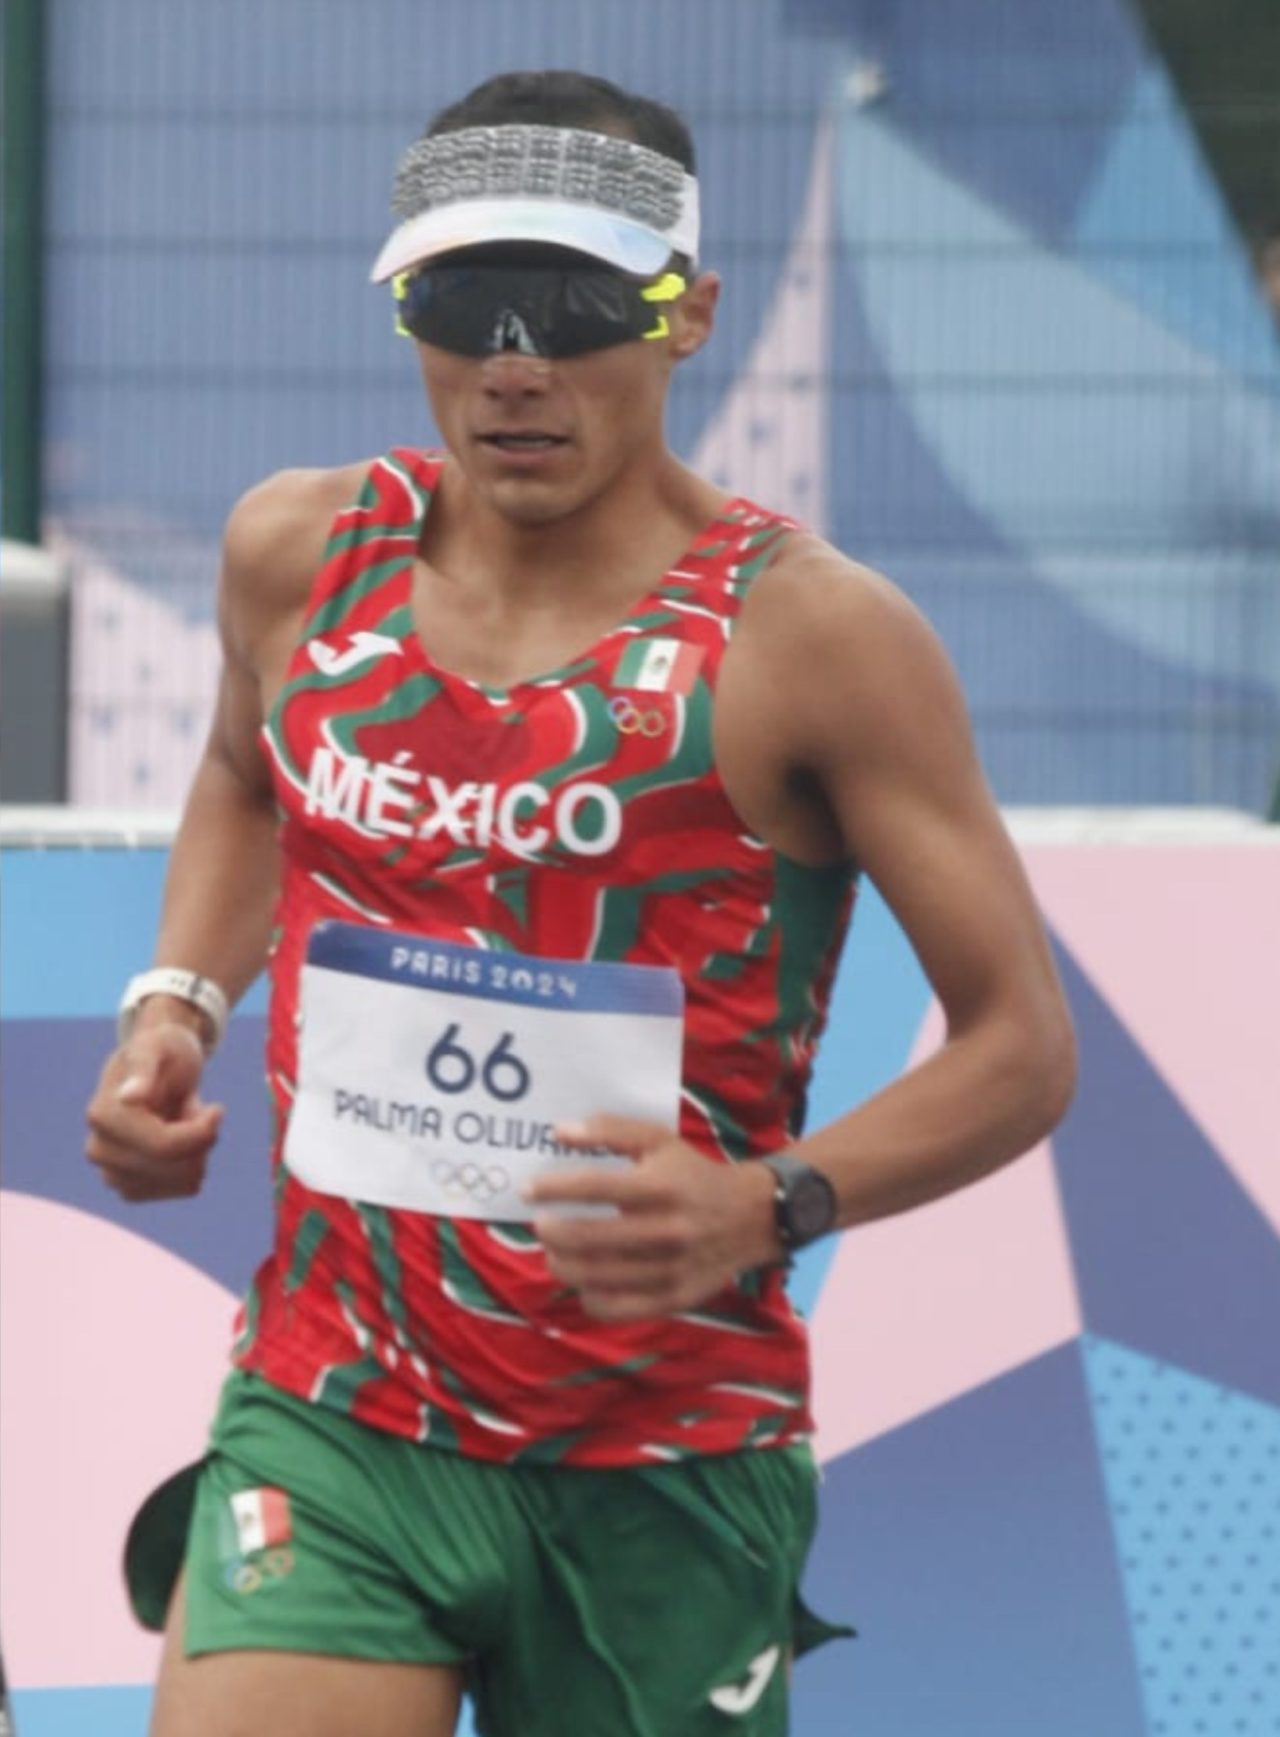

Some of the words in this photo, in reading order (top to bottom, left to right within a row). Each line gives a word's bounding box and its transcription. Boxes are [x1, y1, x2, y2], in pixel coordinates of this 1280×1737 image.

[304, 747, 622, 856] MÉXICO
[490, 964, 576, 998] 2024
[425, 1022, 531, 1102] 66
[334, 1089, 442, 1139] PALMA
